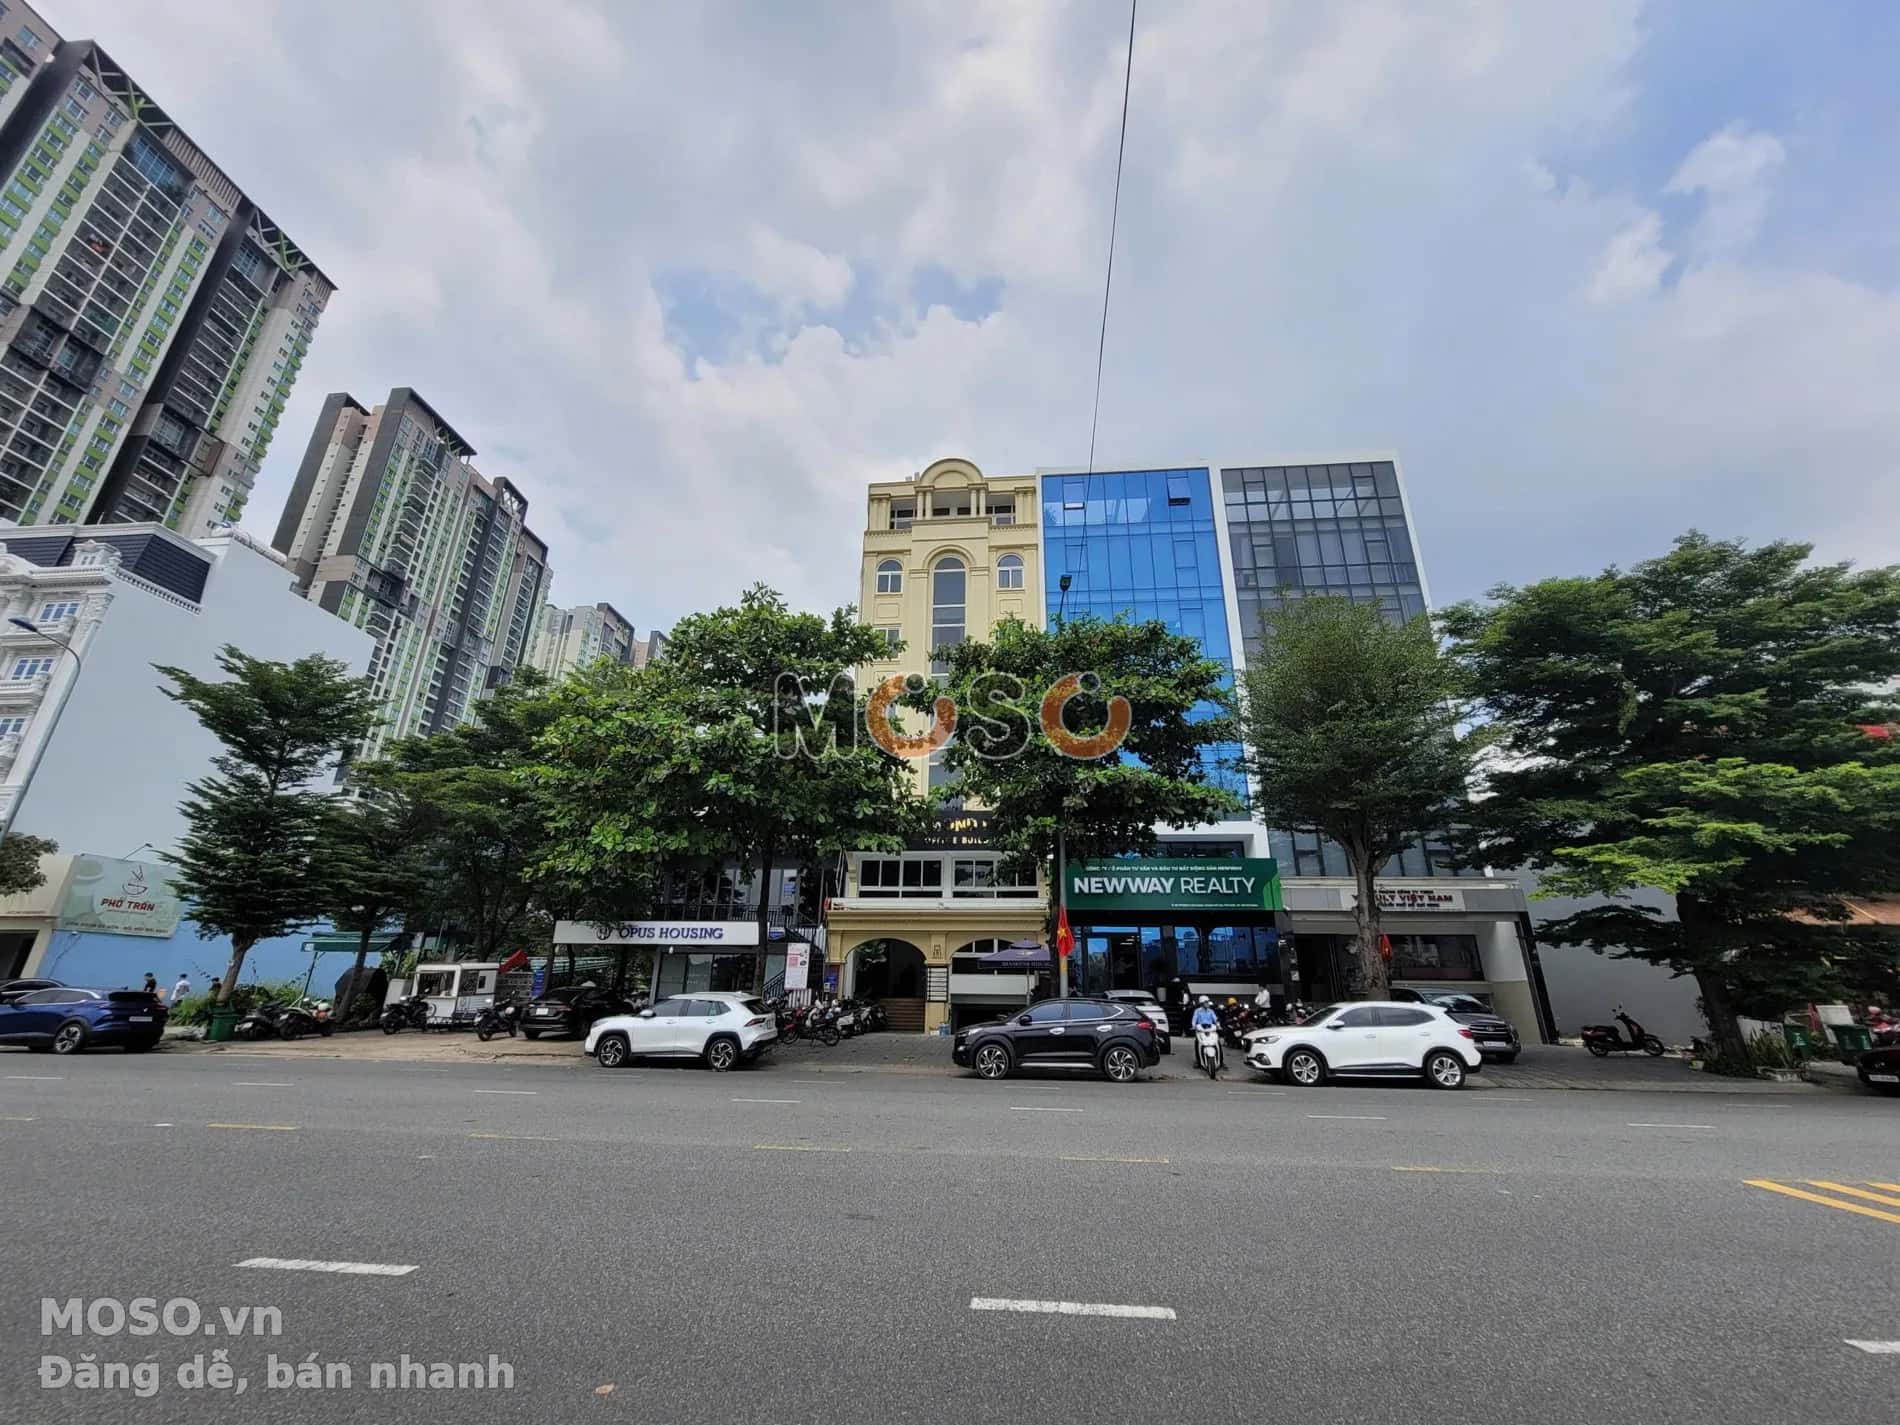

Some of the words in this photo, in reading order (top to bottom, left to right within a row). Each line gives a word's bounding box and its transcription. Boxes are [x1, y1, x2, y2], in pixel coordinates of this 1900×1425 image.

[1074, 877, 1175, 894] NEWWAY
[1180, 877, 1256, 894] REALTY
[619, 926, 655, 939] OPUS
[659, 927, 724, 939] HOUSING
